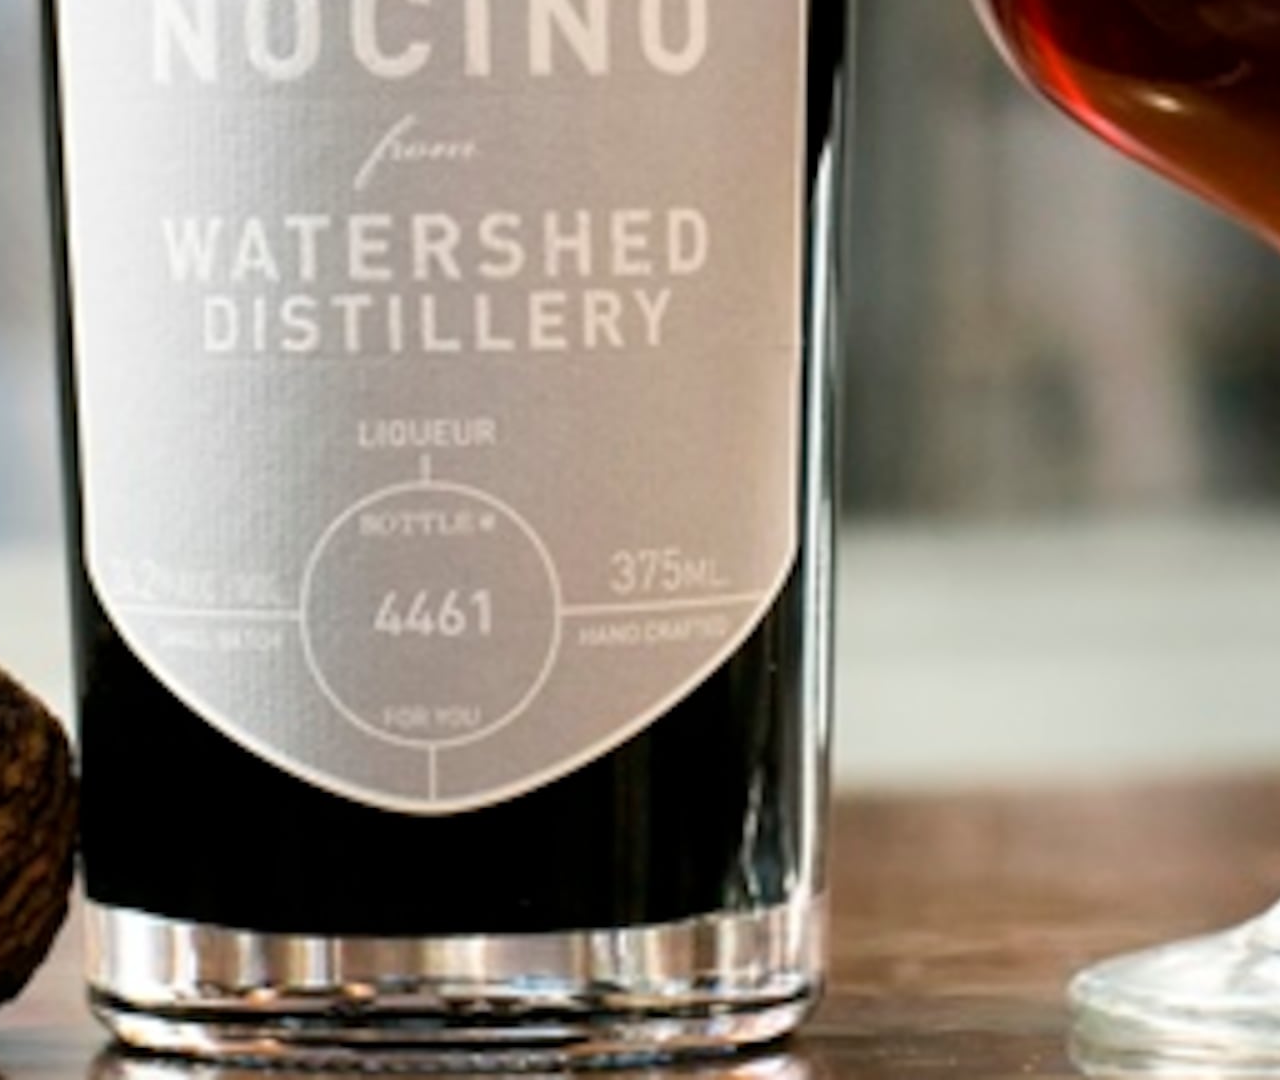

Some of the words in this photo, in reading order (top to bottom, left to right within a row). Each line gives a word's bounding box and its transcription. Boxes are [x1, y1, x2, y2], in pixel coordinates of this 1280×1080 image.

[352, 113, 480, 191] from
[162, 207, 710, 283] WATERSHED
[203, 287, 673, 353] DISTILLERY
[357, 417, 497, 449] LIQUEUR
[373, 588, 493, 637] 4461
[382, 705, 430, 728] FOR
[433, 704, 482, 729] YOU
